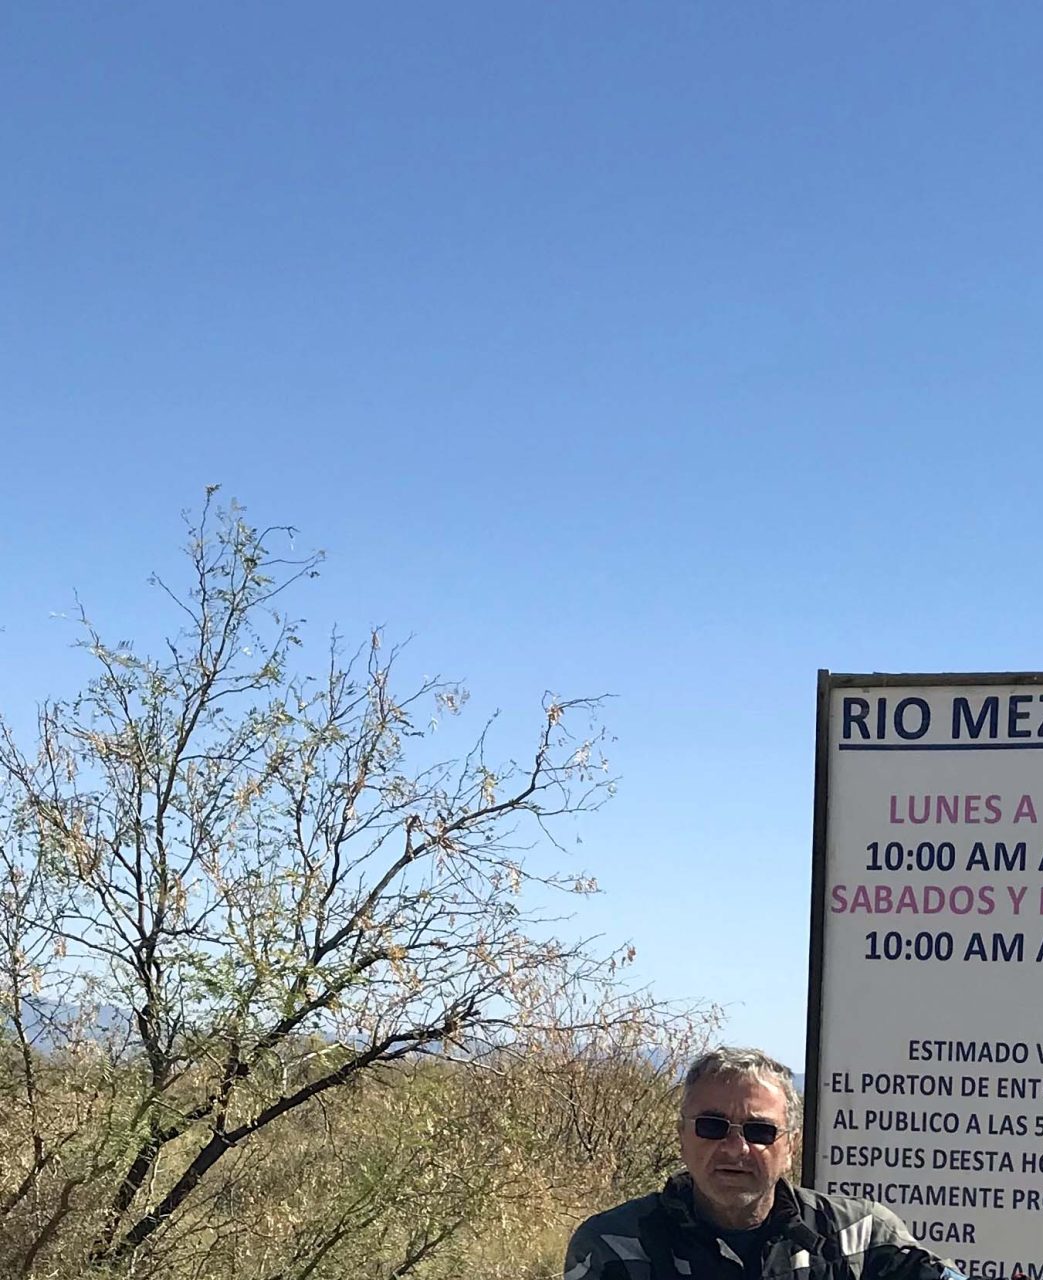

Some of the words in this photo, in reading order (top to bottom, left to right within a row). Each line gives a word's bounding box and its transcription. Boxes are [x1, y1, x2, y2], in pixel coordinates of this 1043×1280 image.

[842, 696, 932, 741] RIO
[889, 794, 1002, 825] LUNES
[1013, 794, 1038, 824] A
[865, 841, 956, 872] 10:00
[965, 841, 1027, 872] AM
[830, 884, 995, 916] SABADOS
[1006, 886, 1028, 915] Y
[864, 930, 954, 962] 10:00
[963, 932, 1025, 963] AM
[908, 1039, 1029, 1064] ESTIMADO
[861, 1073, 953, 1097] PORTON
[960, 1076, 989, 1098] DE
[832, 1108, 859, 1131] AL
[864, 1109, 960, 1134] PUBLICO
[965, 1113, 982, 1135] A
[988, 1113, 1028, 1137] LAS
[826, 1181, 1005, 1209] ESTRICTAMENTE
[911, 1220, 976, 1244] UGAR
